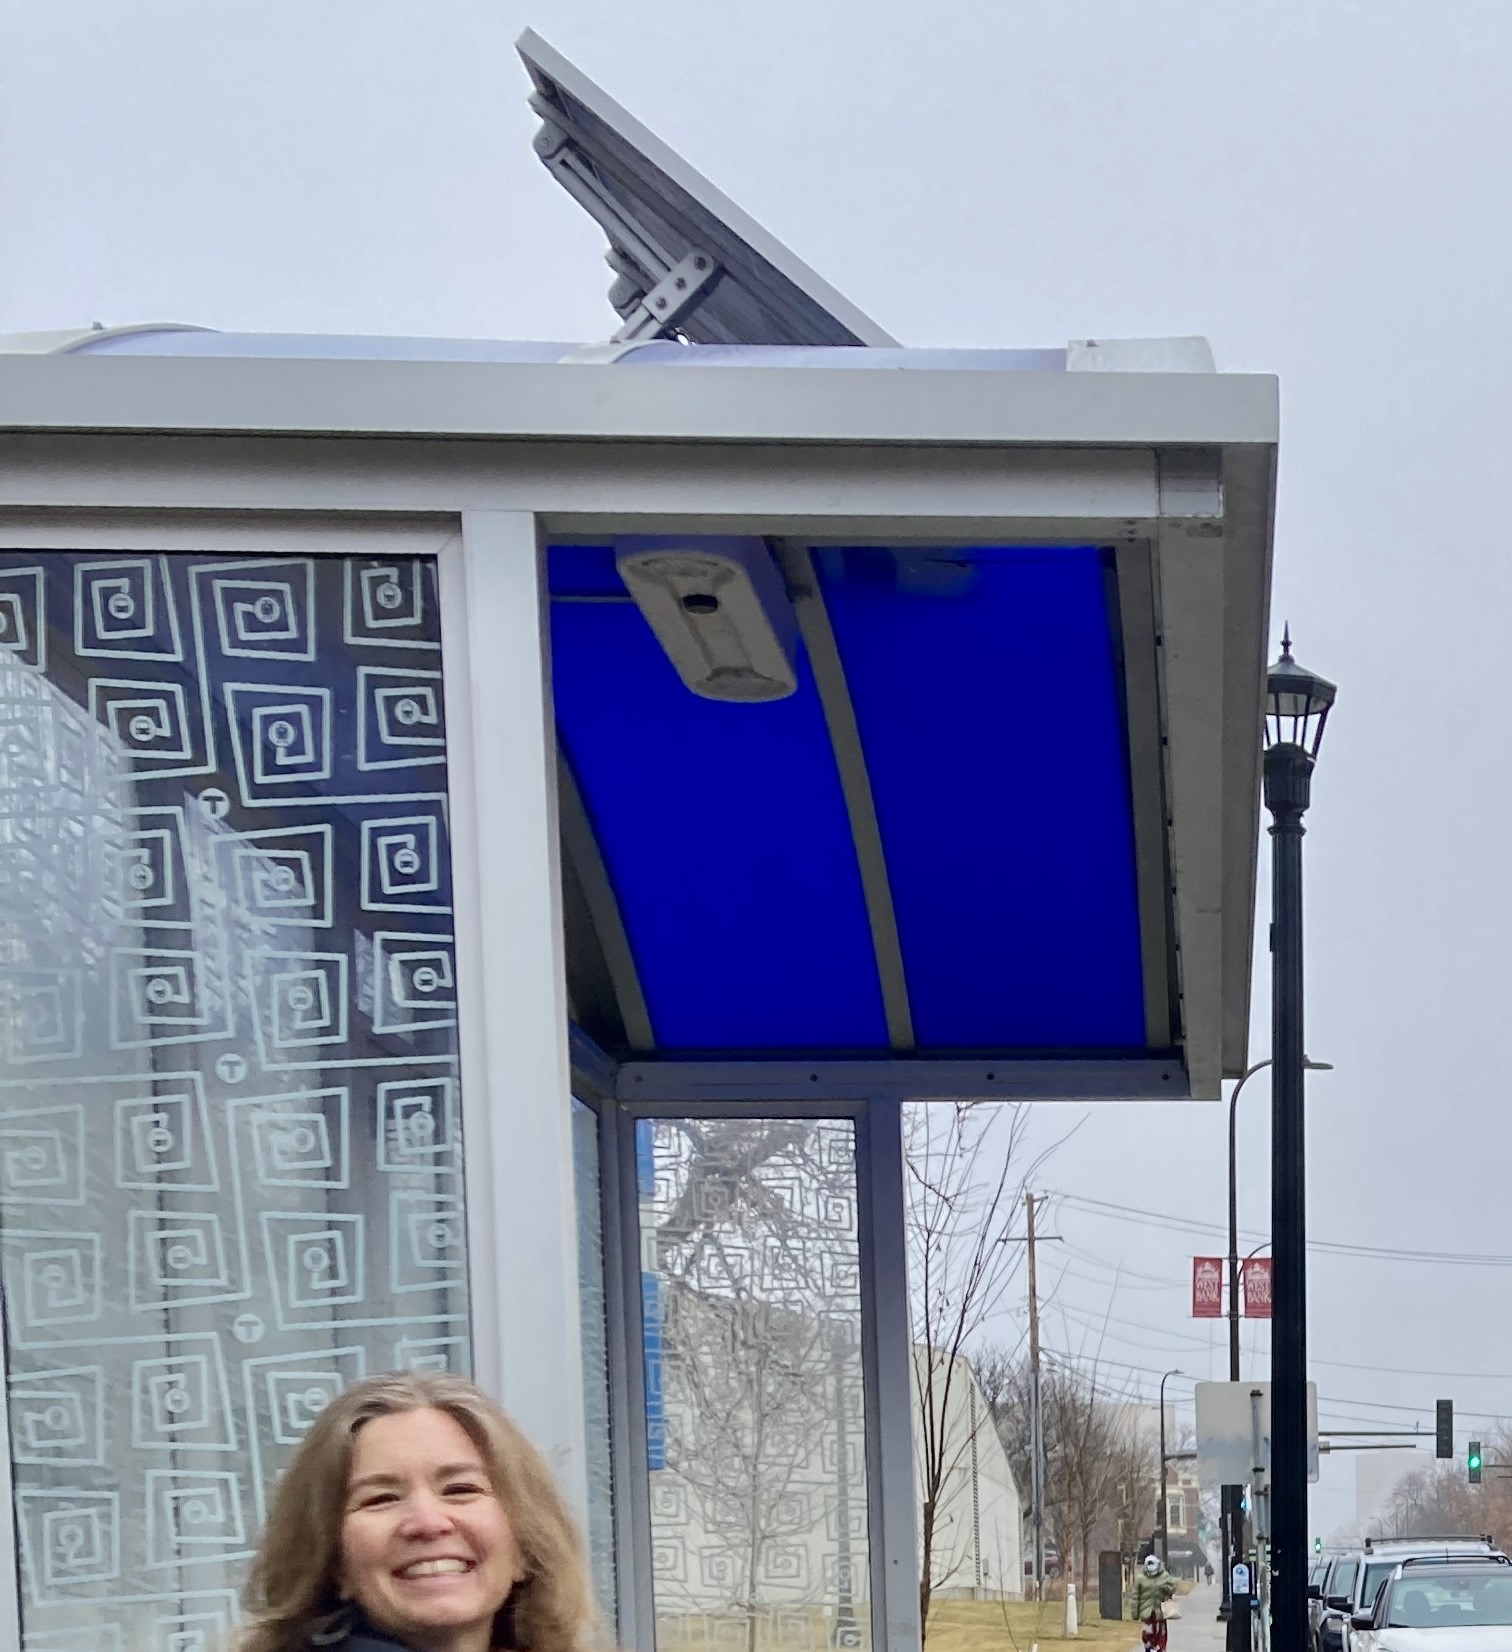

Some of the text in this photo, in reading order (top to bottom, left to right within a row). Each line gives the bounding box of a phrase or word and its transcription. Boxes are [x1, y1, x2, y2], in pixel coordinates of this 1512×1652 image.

[1196, 1280, 1219, 1290] WEST
[1247, 1280, 1270, 1290] WEST
[1195, 1290, 1220, 1303] BANK
[1247, 1291, 1271, 1303] BANK
